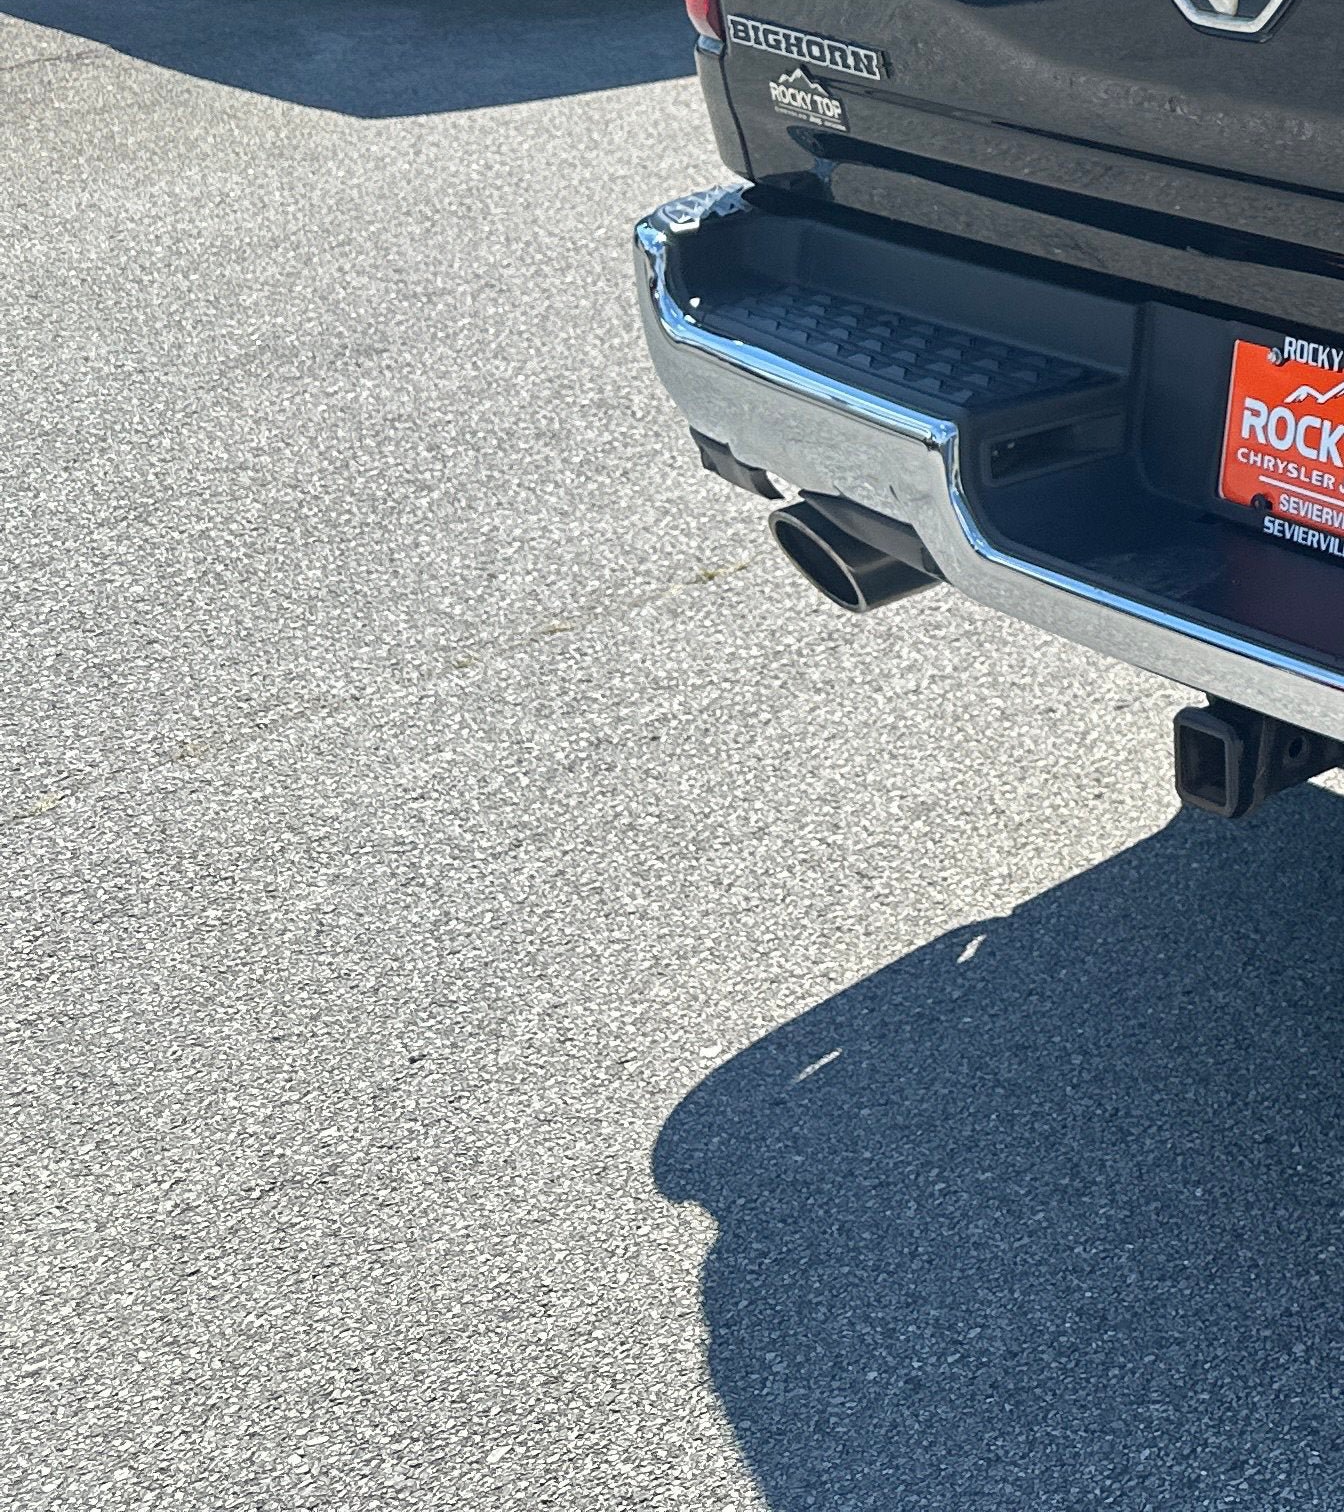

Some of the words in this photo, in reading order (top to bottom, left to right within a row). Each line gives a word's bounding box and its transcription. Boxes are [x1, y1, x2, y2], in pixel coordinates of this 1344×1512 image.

[727, 14, 881, 81] BIGHORN
[769, 81, 812, 111] ROCKY
[813, 94, 842, 119] TOP
[1283, 336, 1343, 372] ROCKY
[1237, 447, 1335, 490] CHRYSLER
